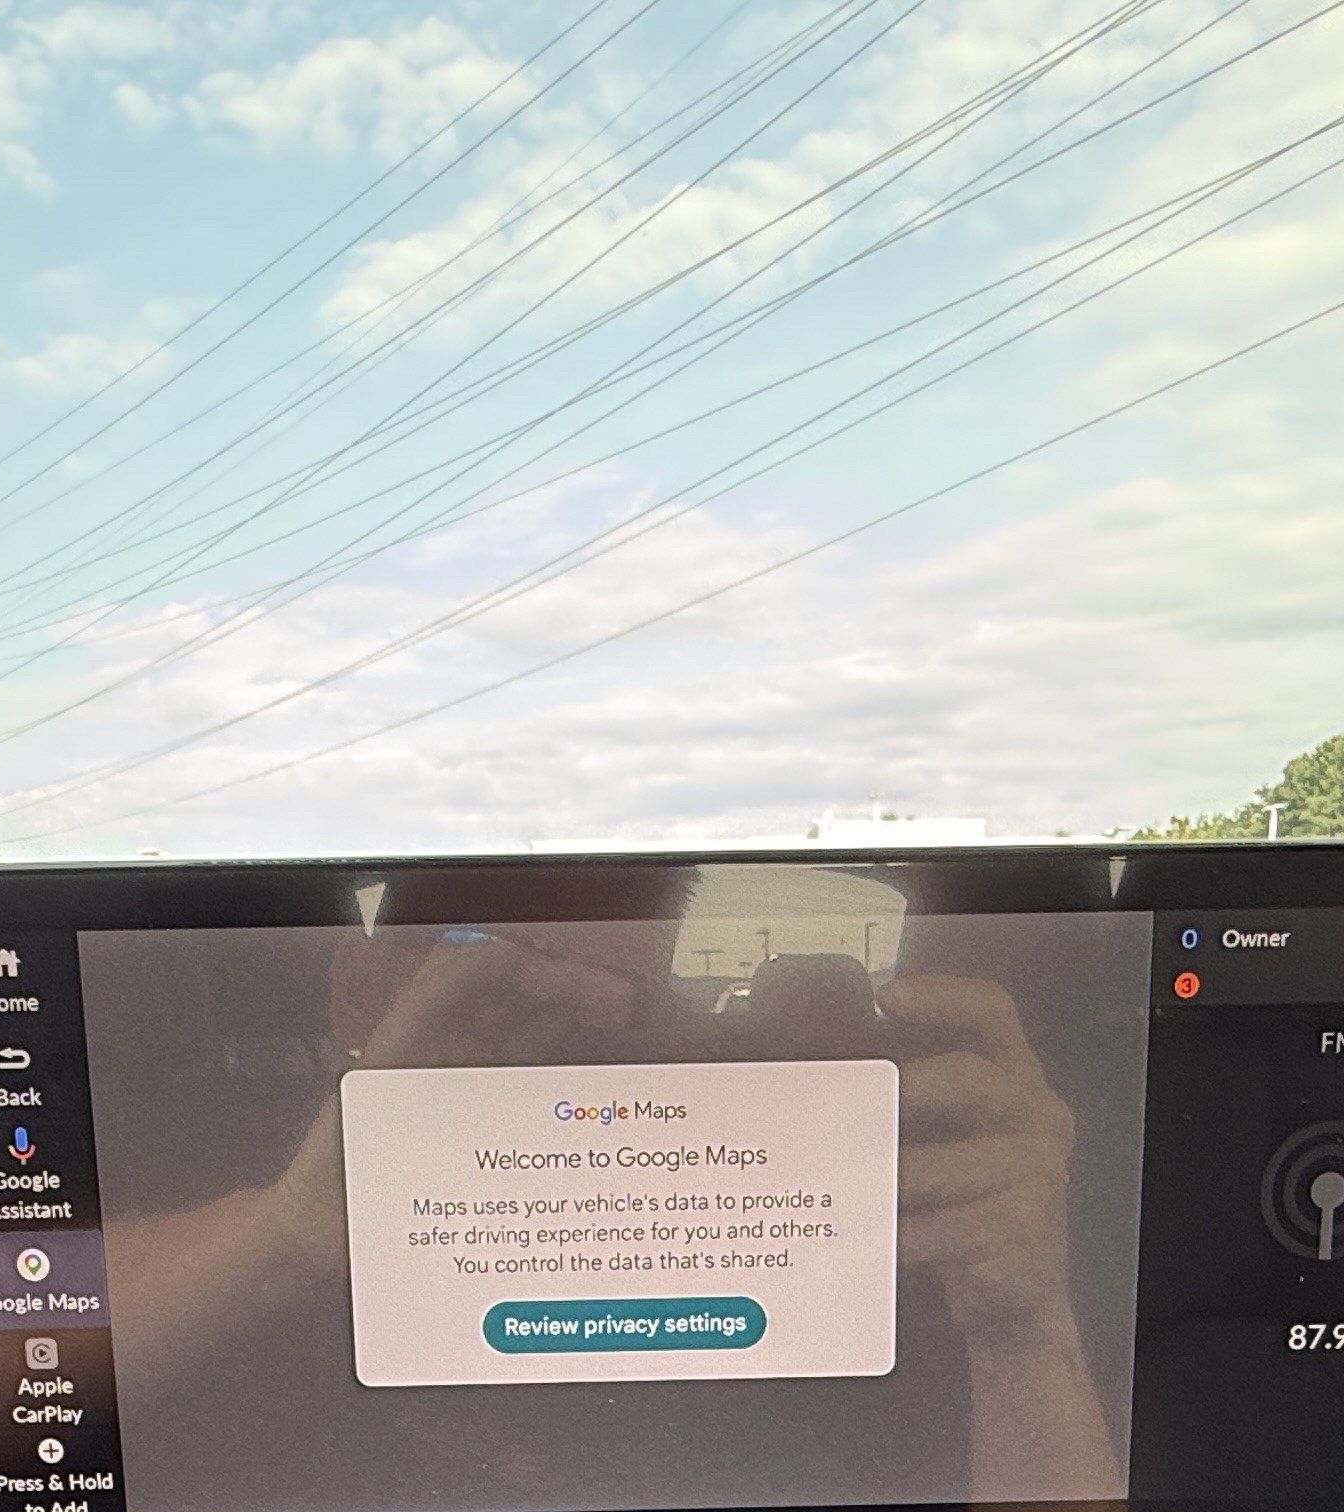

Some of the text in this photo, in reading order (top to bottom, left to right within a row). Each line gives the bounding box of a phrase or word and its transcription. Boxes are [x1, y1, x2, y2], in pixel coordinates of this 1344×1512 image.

[1222, 929, 1291, 949] Owner
[555, 1101, 687, 1125] Google Maps
[475, 1146, 768, 1171] Welcome to Google Maps
[413, 1190, 832, 1220] Maps uses your vehicle's data to provide a
[409, 1219, 838, 1248] safer driving experience for you and others.
[453, 1249, 794, 1275] You control the data that's shared.
[49, 1294, 99, 1313] Maps
[505, 1313, 747, 1338] Review privacy settings
[18, 1378, 73, 1397] Apple
[12, 1406, 83, 1426] CarPlay
[49, 1474, 63, 1491] &
[68, 1473, 114, 1490] Hold
